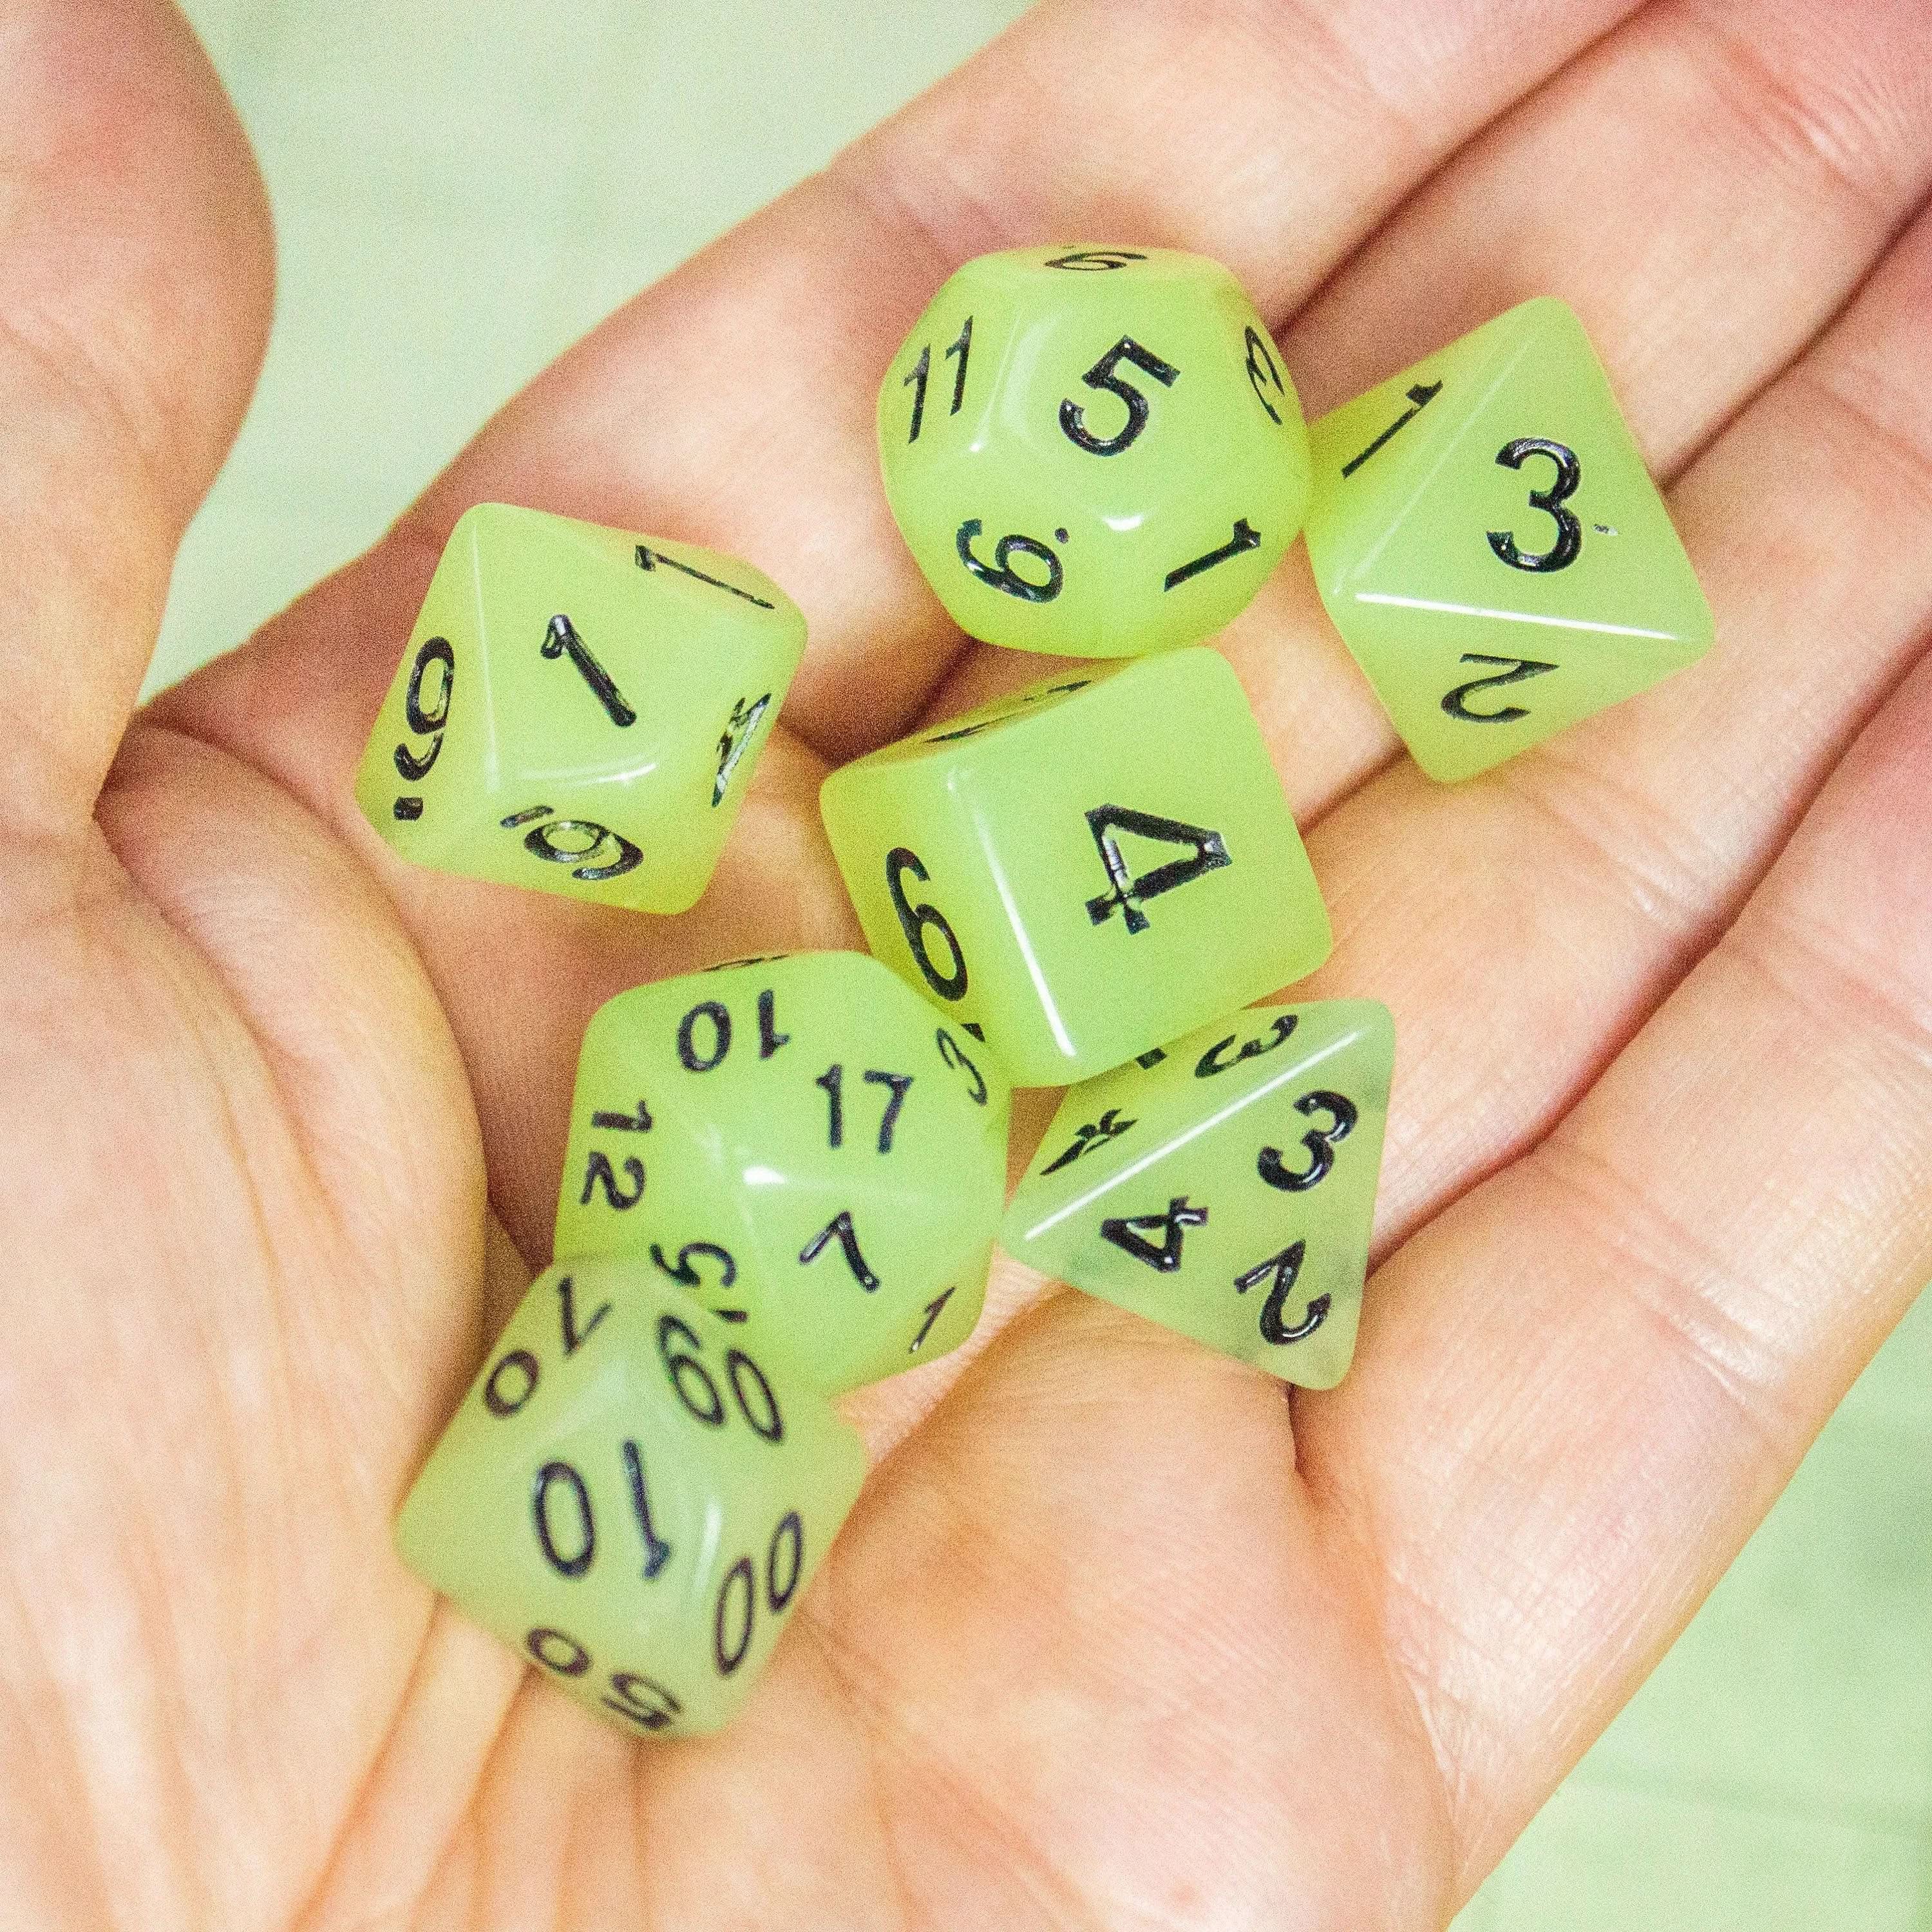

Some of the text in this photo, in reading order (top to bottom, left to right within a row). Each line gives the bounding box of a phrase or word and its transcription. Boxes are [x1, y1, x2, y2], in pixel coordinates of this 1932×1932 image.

[904, 315, 974, 444] 11
[1058, 335, 1180, 457] 5
[1244, 325, 1286, 426] 3
[1341, 380, 1443, 479] 1
[1164, 518, 1261, 592] 1
[1486, 437, 1582, 573] 3
[540, 614, 637, 728] 1
[1441, 652, 1559, 723] 2
[1084, 803, 1233, 935] 4
[676, 989, 790, 1073] 10
[936, 1027, 988, 1106] 3
[1194, 1014, 1298, 1078] 3
[580, 1099, 654, 1211] 12
[815, 1063, 913, 1155] 17
[1258, 1090, 1358, 1193] 3
[1100, 1196, 1209, 1273] 4
[909, 1285, 956, 1353] 1
[1233, 1239, 1332, 1346] 2
[532, 1439, 672, 1580] 10
[714, 1510, 804, 1677] 00
[526, 1626, 682, 1730] 50
